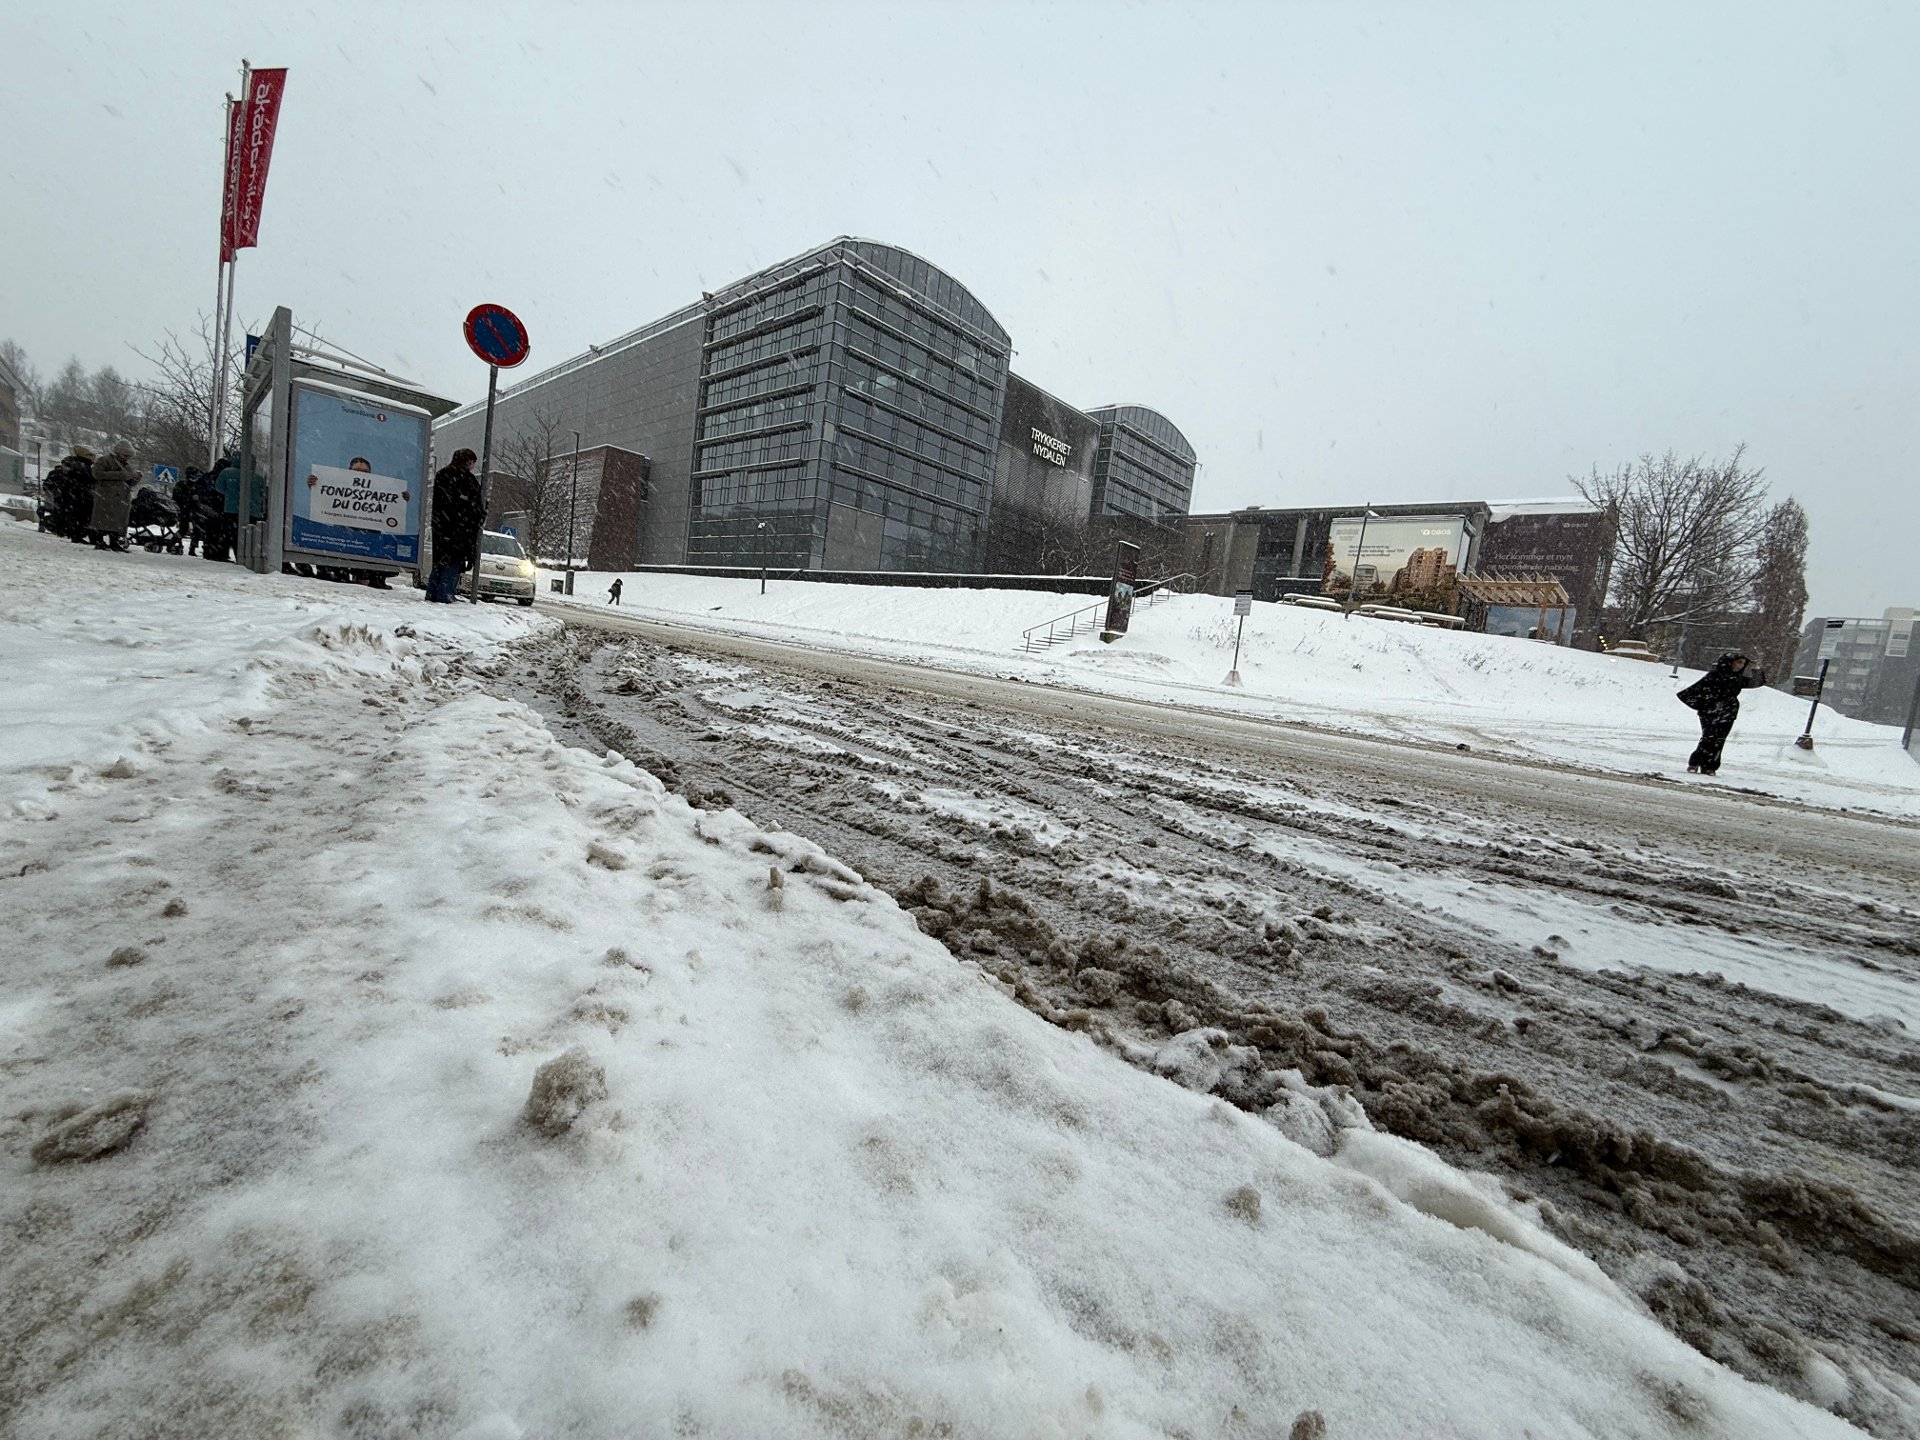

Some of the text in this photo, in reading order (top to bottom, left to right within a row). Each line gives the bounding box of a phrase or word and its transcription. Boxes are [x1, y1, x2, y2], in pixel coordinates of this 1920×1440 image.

[1031, 427, 1072, 456] TRYKKERIET
[1032, 442, 1067, 467] NYDALEN
[352, 477, 371, 489] BLI
[320, 485, 399, 504] FONDSSPARER
[332, 498, 388, 514] DU OGSÅ!
